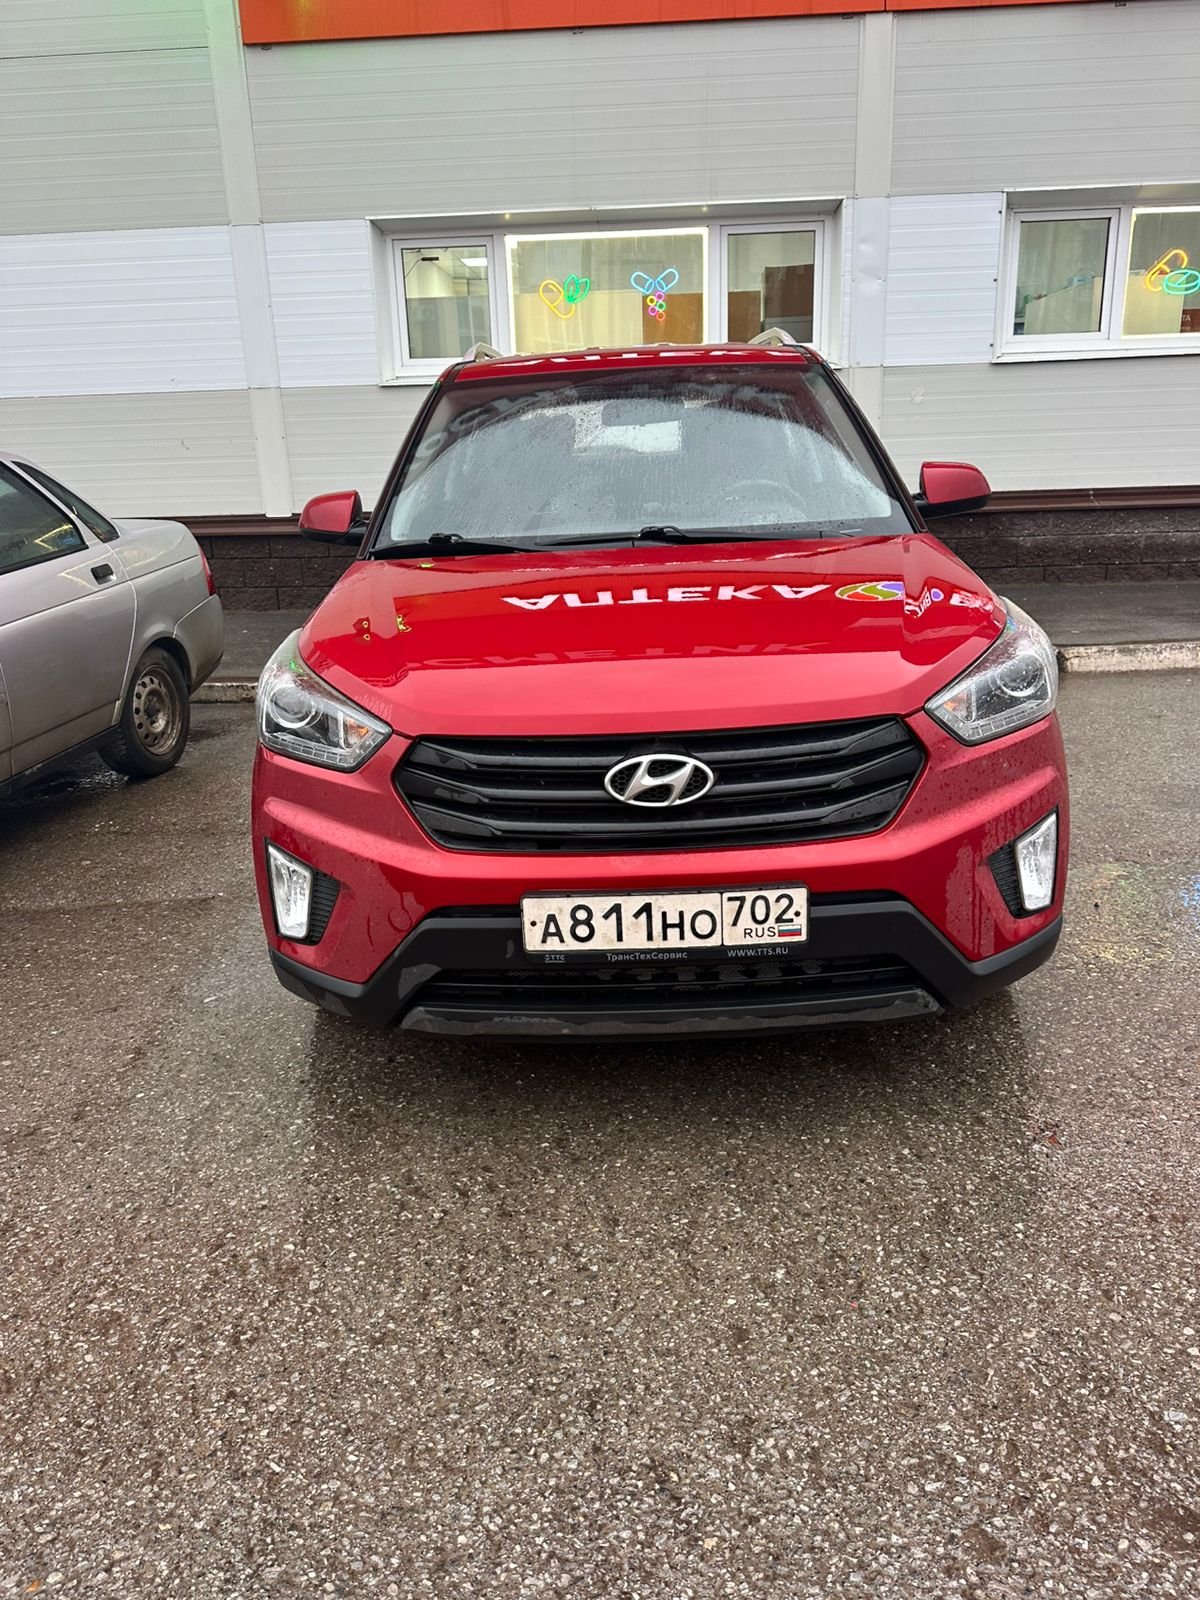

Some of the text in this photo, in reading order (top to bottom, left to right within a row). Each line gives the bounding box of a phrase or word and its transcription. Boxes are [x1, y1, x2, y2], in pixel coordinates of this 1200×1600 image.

[726, 893, 795, 928] 702
[743, 926, 777, 939] RUS
[606, 950, 688, 962] ТрансТехСервис
[727, 946, 789, 958] WWW.TTS.RU
